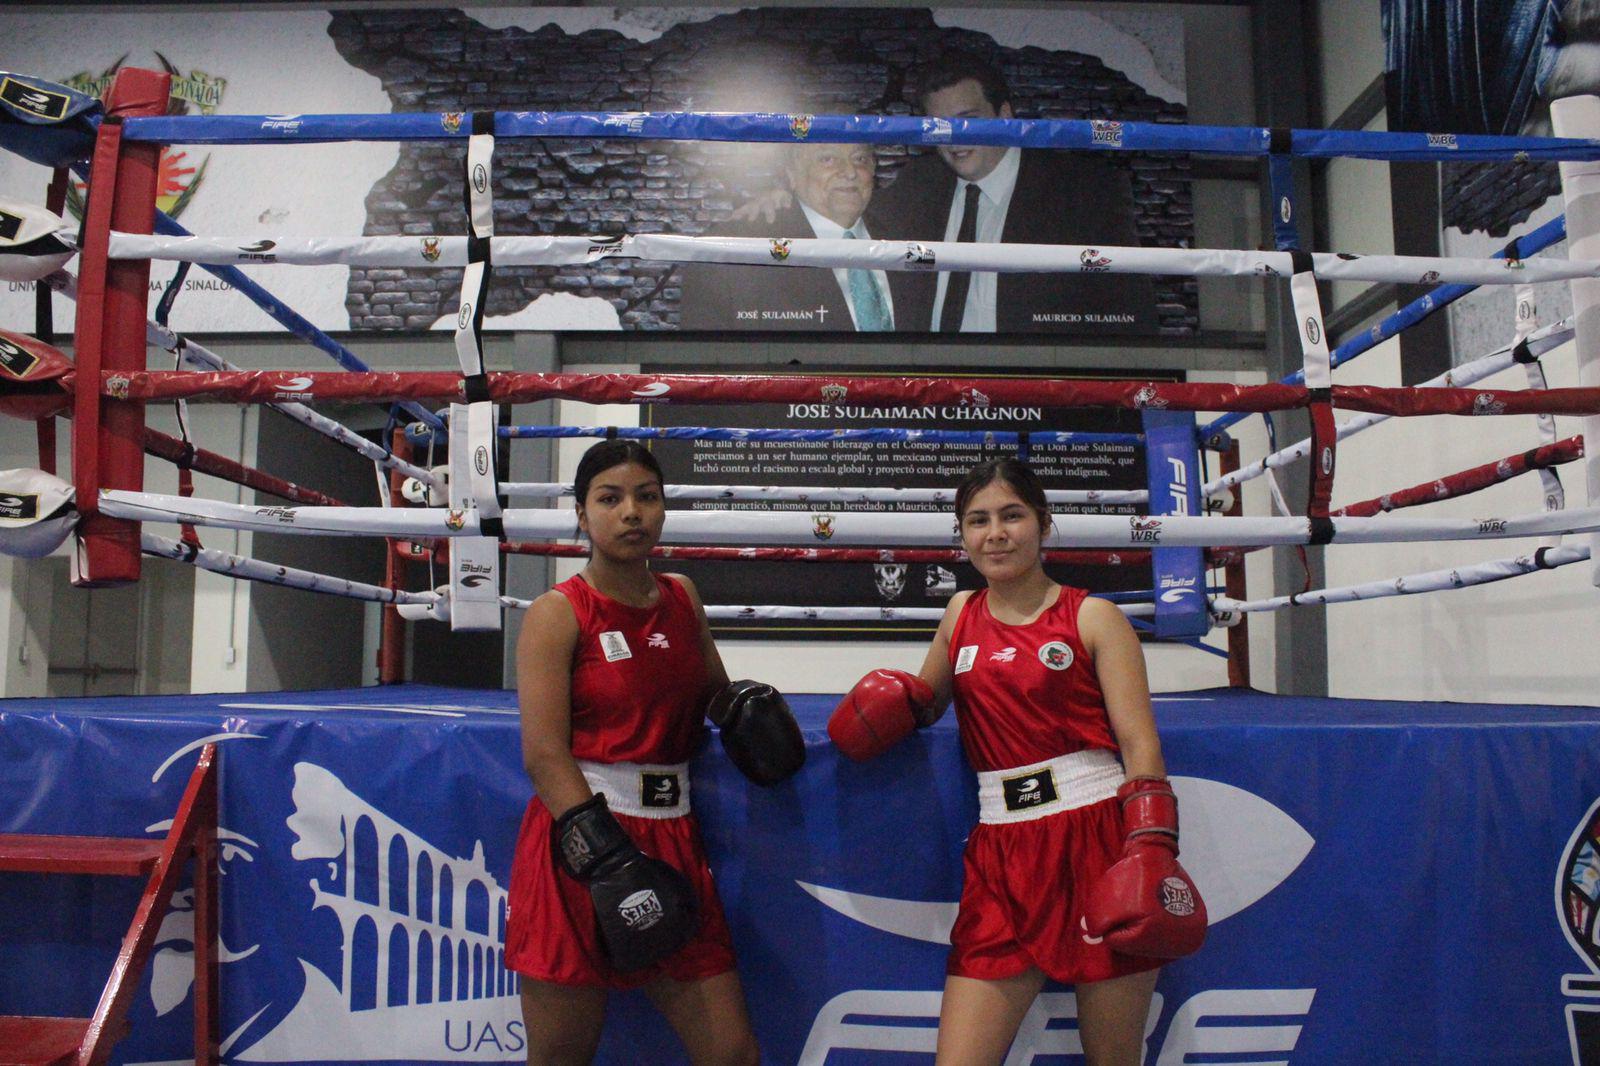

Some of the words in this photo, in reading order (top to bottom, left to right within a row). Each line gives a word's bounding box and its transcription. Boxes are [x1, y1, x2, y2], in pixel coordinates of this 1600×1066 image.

[261, 121, 300, 129] FIRE
[1093, 131, 1120, 141] WBC
[1429, 135, 1456, 145] WBC
[185, 280, 238, 291] SINALO
[736, 310, 758, 319] JOSÉ
[761, 310, 813, 319] SULAIMÁN
[1032, 313, 1081, 322] MAURICIO
[1084, 313, 1135, 322] SULAIMÁN
[941, 407, 1041, 420] CHAGNON
[735, 440, 747, 448] de
[833, 440, 873, 451] liderazgo
[891, 441, 899, 449] el
[903, 441, 940, 452] Consejo
[1047, 444, 1067, 452] Don
[693, 452, 745, 462] apreciamos
[790, 452, 828, 461] humano
[831, 452, 874, 462] ejemplar,
[892, 453, 937, 461] mexicano
[940, 453, 981, 462] universal
[1060, 456, 1116, 466] responsable,
[1118, 458, 1135, 467] que
[693, 463, 719, 473] luchó
[721, 465, 750, 473] contra
[752, 464, 760, 473] el
[763, 465, 799, 473] racismo
[808, 465, 836, 474] escala
[837, 464, 865, 476] global
[867, 467, 873, 475] y
[875, 465, 915, 476] proyectó
[936, 465, 974, 476] dignida
[1033, 467, 1063, 476] ueblos
[1167, 457, 1188, 516] FIR
[692, 502, 728, 511] siempre
[731, 502, 770, 511] practicó,
[773, 502, 808, 510] mismos
[811, 504, 826, 512] que
[830, 502, 841, 510] ha
[843, 502, 886, 511] heredado
[896, 502, 940, 512] Mauricio,
[1081, 506, 1098, 514] que
[1101, 504, 1115, 513] fue
[1118, 503, 1136, 513] más
[1480, 520, 1507, 532] WBC
[1131, 530, 1161, 541] WBC
[460, 563, 492, 573] FIRE
[1160, 576, 1196, 588] FIRE
[620, 893, 662, 926] REYES
[796, 988, 1317, 1066] FRE
[445, 1019, 525, 1052] UAS
